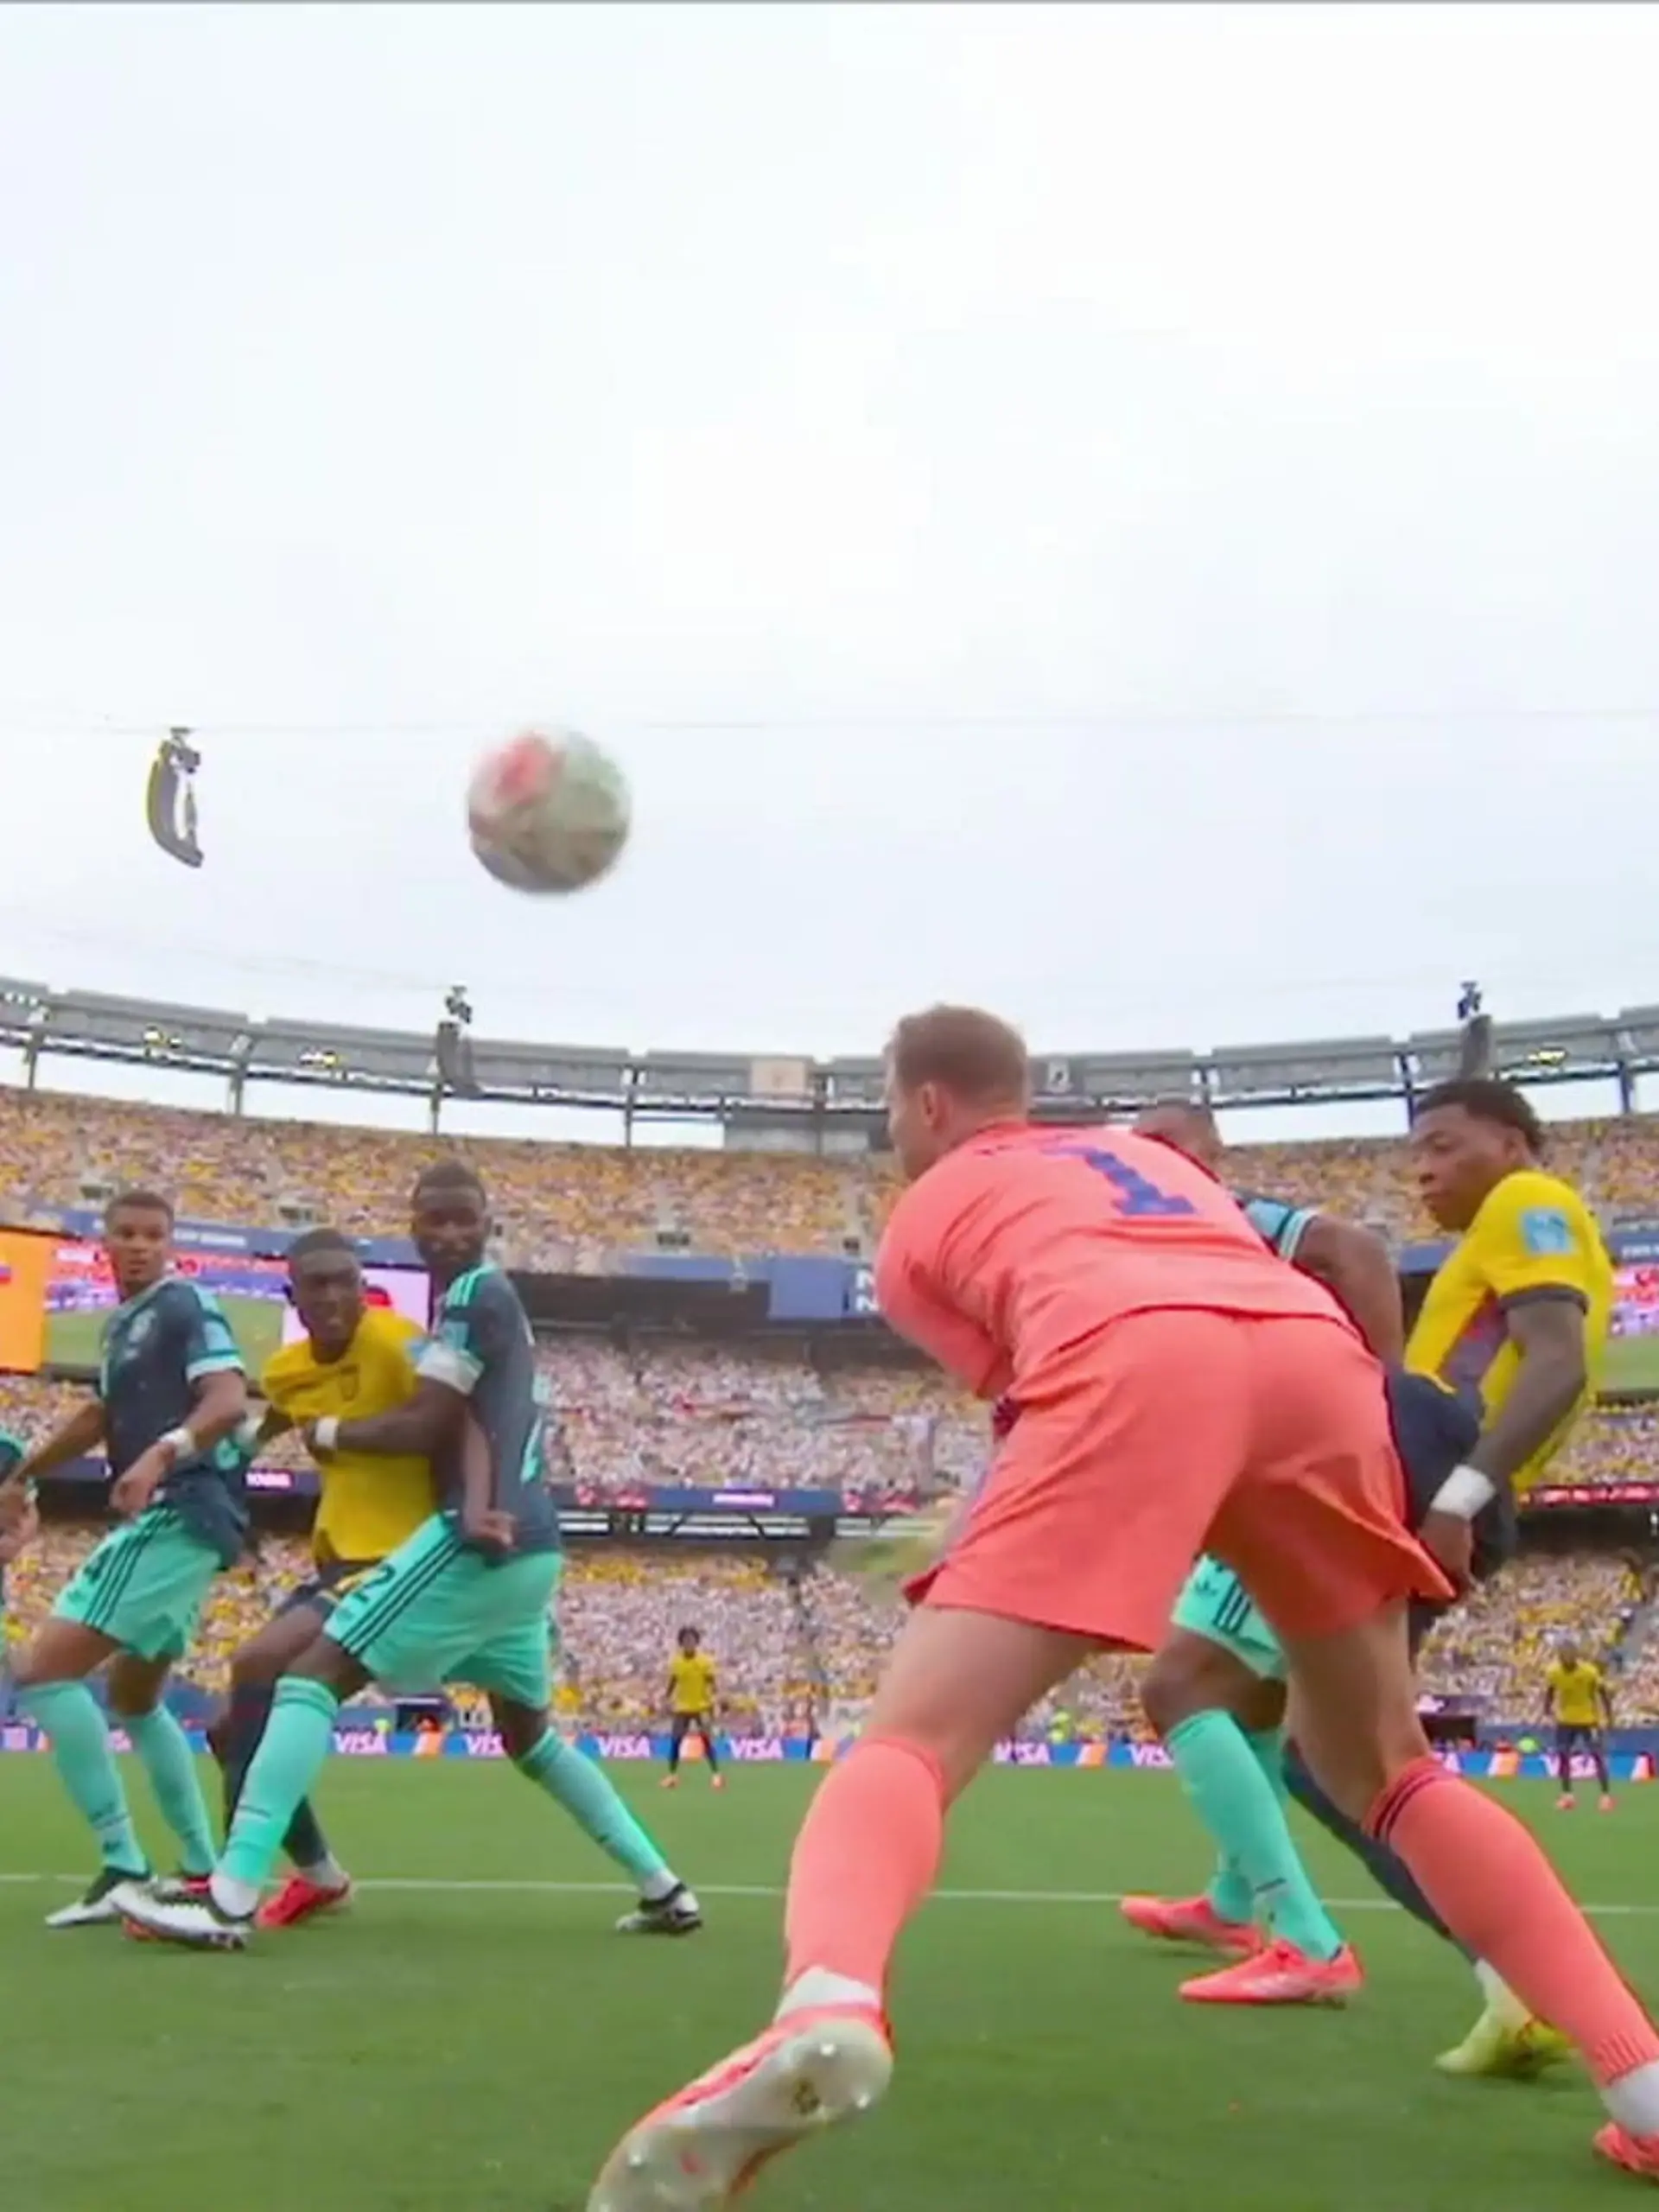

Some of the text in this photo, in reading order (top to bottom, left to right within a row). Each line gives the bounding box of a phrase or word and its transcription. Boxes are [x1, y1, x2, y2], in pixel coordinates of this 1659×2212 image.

[1040, 1146, 1196, 1215] 1
[353, 1562, 397, 1605] 2
[333, 1731, 387, 1755] VISA
[464, 1731, 506, 1756] VIS
[595, 1736, 651, 1758] VISA
[728, 1738, 783, 1759] VISA
[993, 1742, 1051, 1764] VISA
[1128, 1744, 1173, 1766] VIS
[1539, 1752, 1598, 1777] VSA
